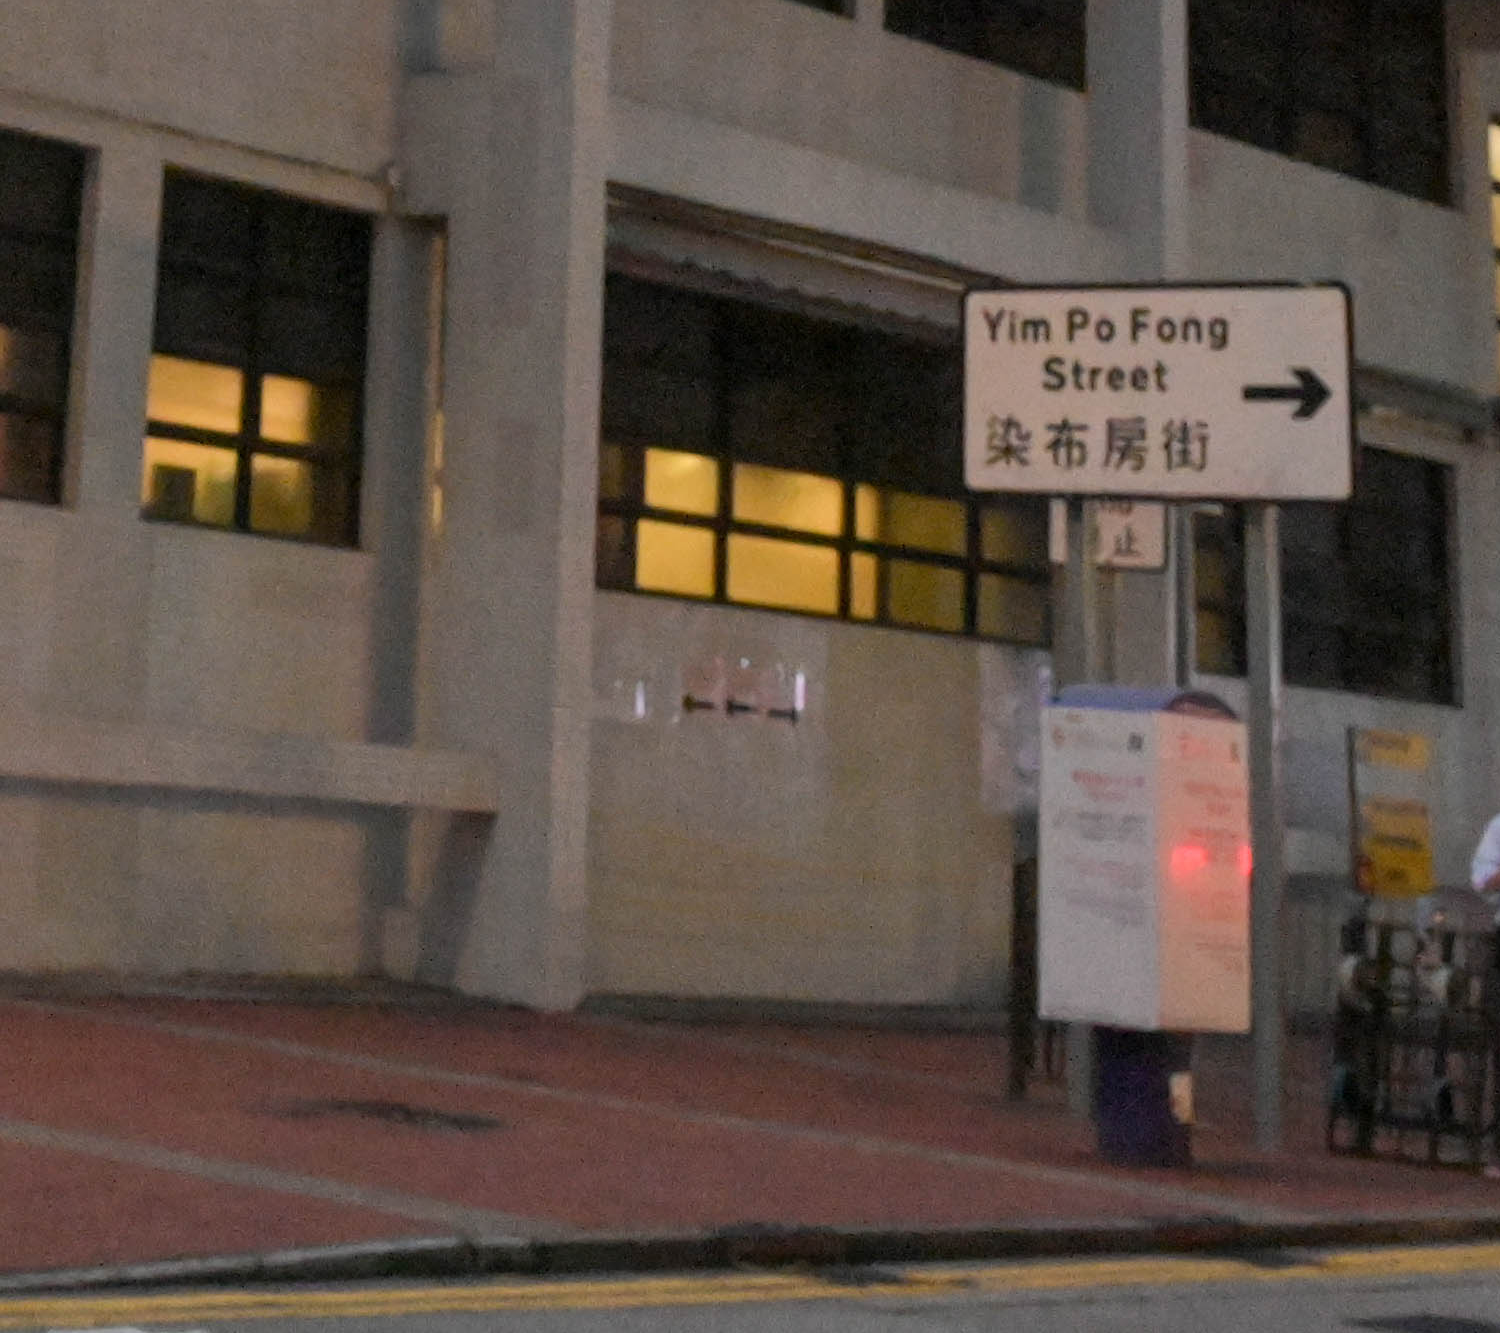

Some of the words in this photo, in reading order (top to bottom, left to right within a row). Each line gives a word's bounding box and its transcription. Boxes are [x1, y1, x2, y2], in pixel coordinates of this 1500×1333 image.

[982, 308, 1051, 343] Yim
[1066, 309, 1117, 345] Po
[1129, 307, 1231, 352] Fong
[1042, 356, 1170, 393] Street
[983, 415, 1211, 472] 染布房街
